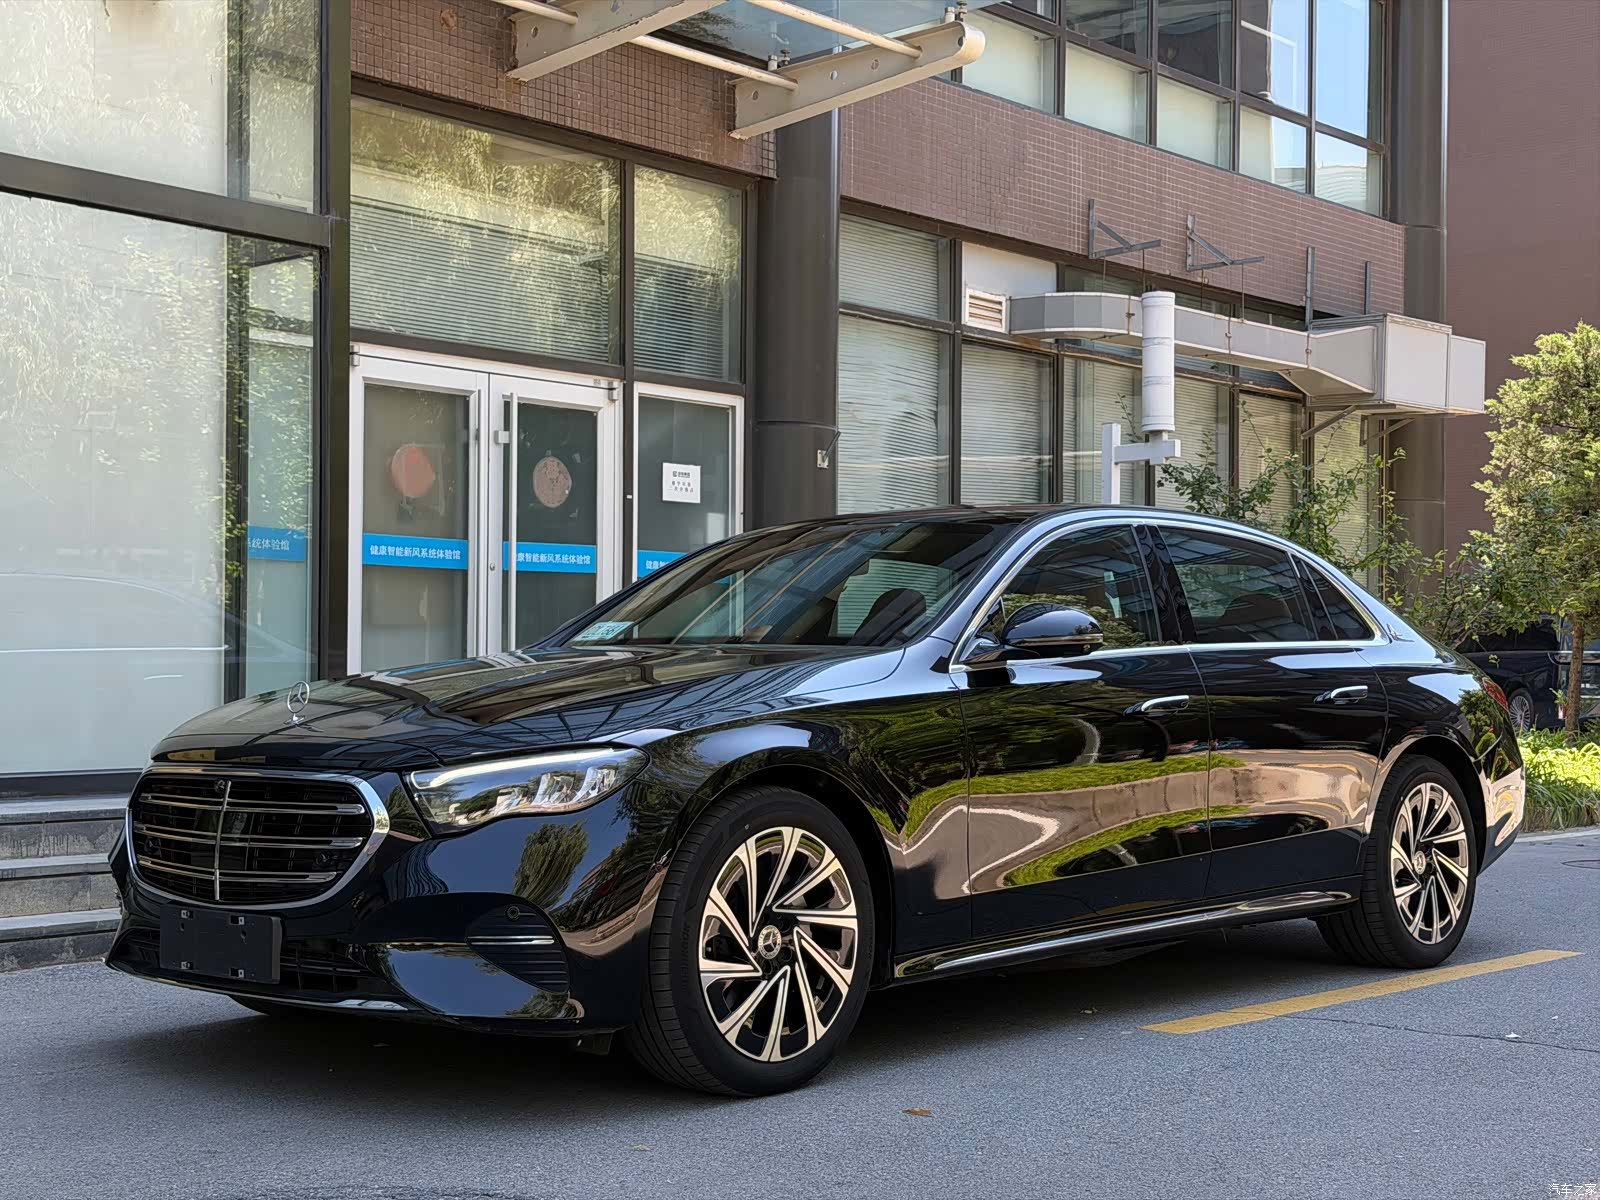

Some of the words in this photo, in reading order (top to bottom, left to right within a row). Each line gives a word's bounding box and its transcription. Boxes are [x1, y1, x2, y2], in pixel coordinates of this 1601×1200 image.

[370, 545, 461, 560] 健康智能新风系统体验馆
[516, 552, 591, 565] 康智能新风系统体验馆
